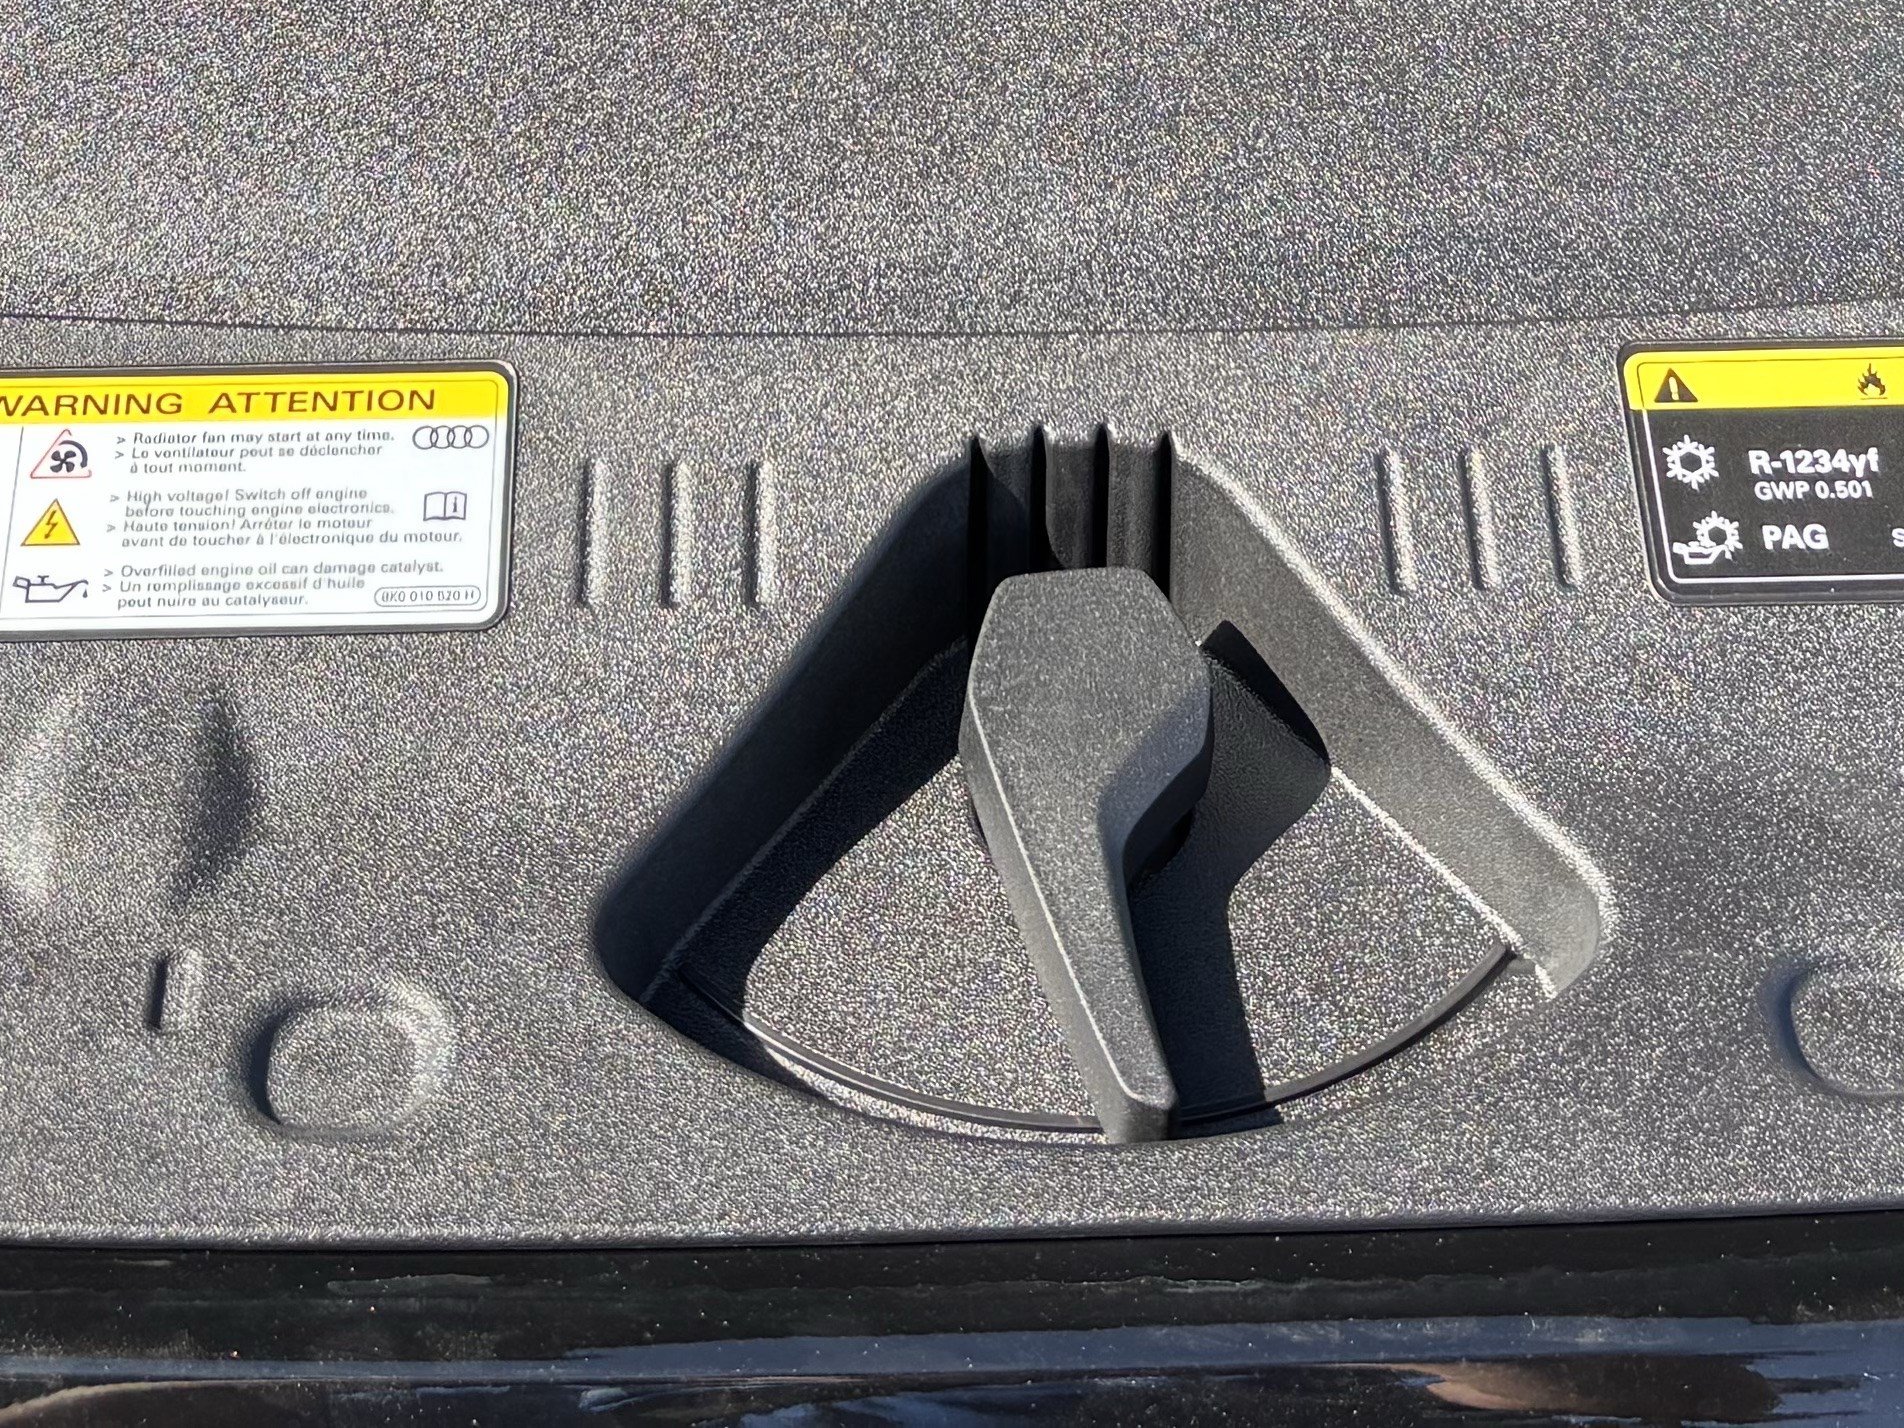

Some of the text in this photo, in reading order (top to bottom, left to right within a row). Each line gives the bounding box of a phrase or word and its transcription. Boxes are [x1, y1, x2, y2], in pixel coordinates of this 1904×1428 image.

[208, 389, 436, 415] ATTENTION
[133, 429, 395, 445] Radiator fan may start at any time.
[131, 447, 150, 459] Le
[154, 446, 235, 459] ventilateur
[239, 446, 273, 459] peut
[278, 447, 295, 457] se
[1748, 446, 1880, 477] R-1234yf
[143, 461, 174, 473] tout
[178, 462, 247, 473] moment.
[126, 490, 163, 504] High
[235, 489, 286, 502] Switch
[291, 488, 311, 500] off
[316, 487, 368, 503] engine
[1754, 479, 1874, 501] GWP 0.501
[125, 501, 395, 519] before touching engine electronics.
[124, 520, 168, 533] Haute
[298, 518, 312, 529] le
[316, 517, 373, 529] moteur
[122, 537, 164, 548] avant
[169, 535, 188, 547] de
[192, 534, 251, 546] toucher
[379, 530, 398, 543] du
[403, 530, 463, 543] moteur.
[1761, 523, 1828, 550] PAG
[120, 560, 444, 579] Overfilled engine oil can damage catalyst.
[119, 581, 142, 593] Un
[146, 580, 241, 595] remplissage
[246, 579, 308, 591] excessif
[117, 593, 309, 611] peut nuire au catalyseur.
